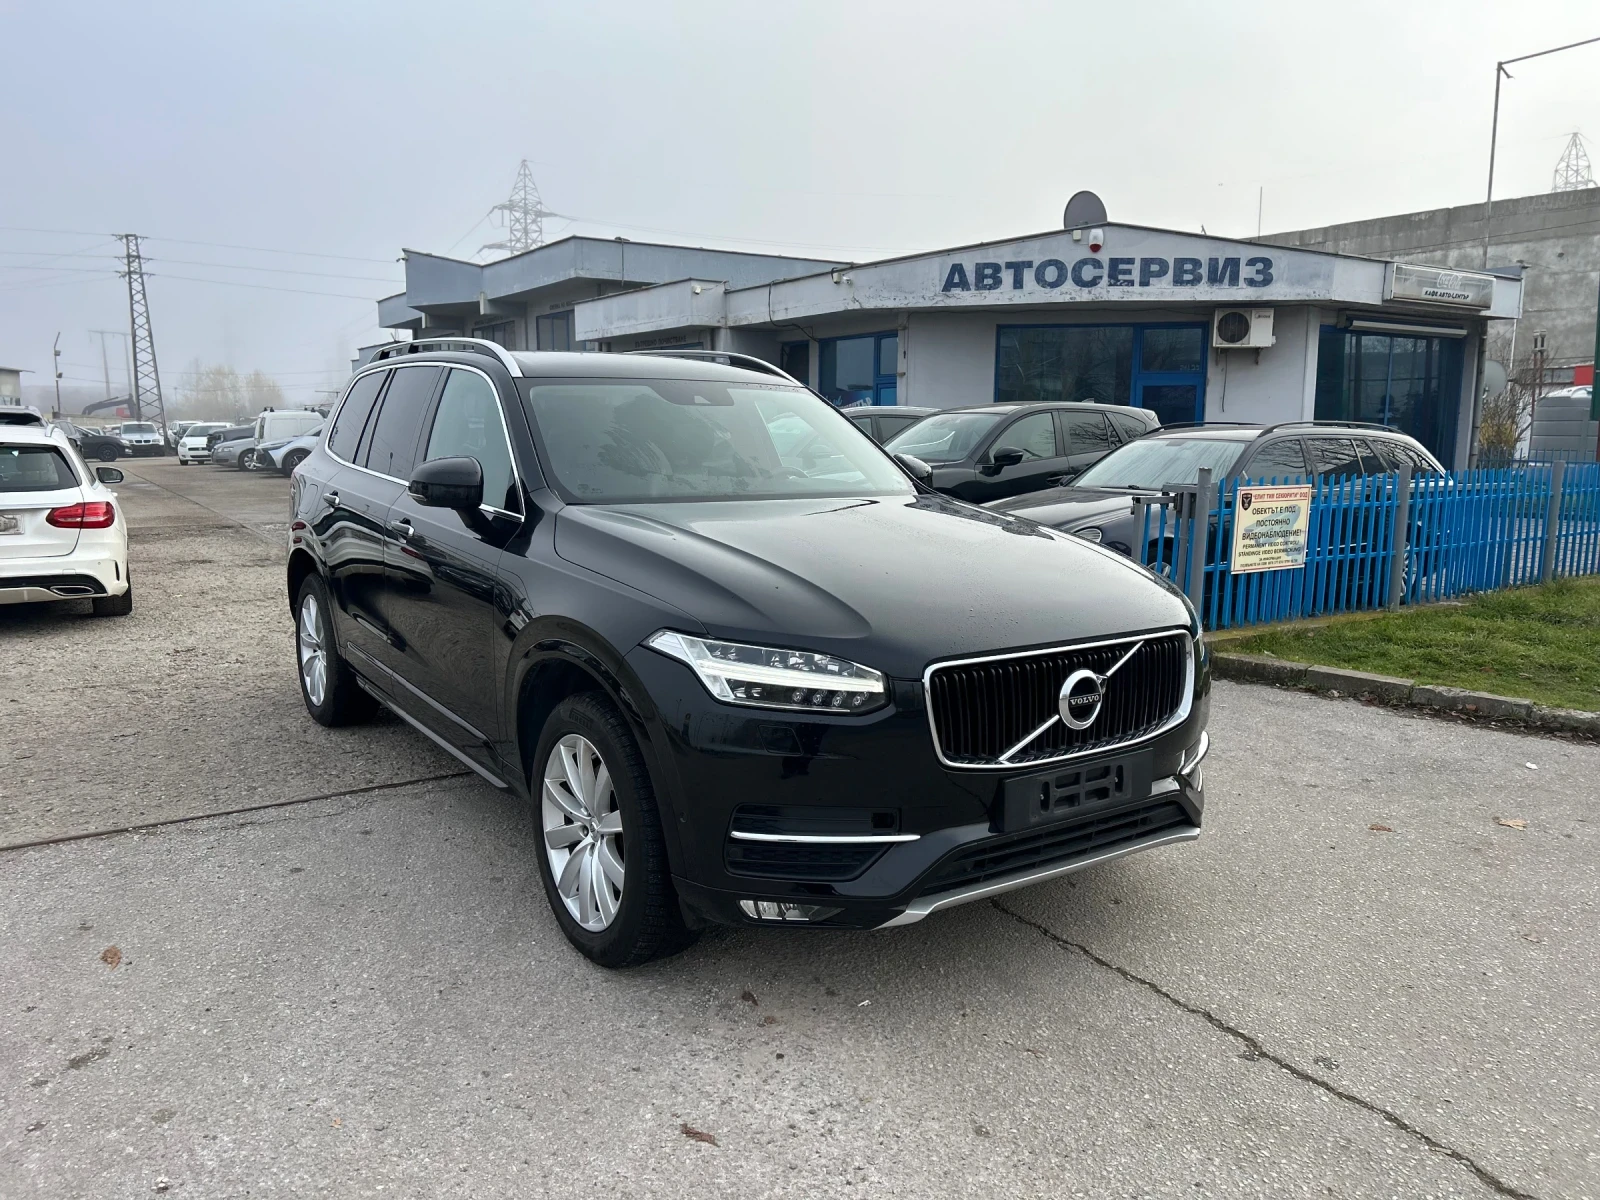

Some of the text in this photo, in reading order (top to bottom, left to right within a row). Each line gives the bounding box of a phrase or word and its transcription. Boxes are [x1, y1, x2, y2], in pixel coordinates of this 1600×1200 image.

[941, 256, 1274, 293] АВТОСЕРВИЗ
[1252, 507, 1278, 515] ОБЕКТЪТ
[1256, 519, 1290, 527] ПОСТОЯННО
[1242, 529, 1302, 540] ВИДЕОНАБЛЮДЕНИЕ!
[1070, 695, 1099, 705] VOLVO
